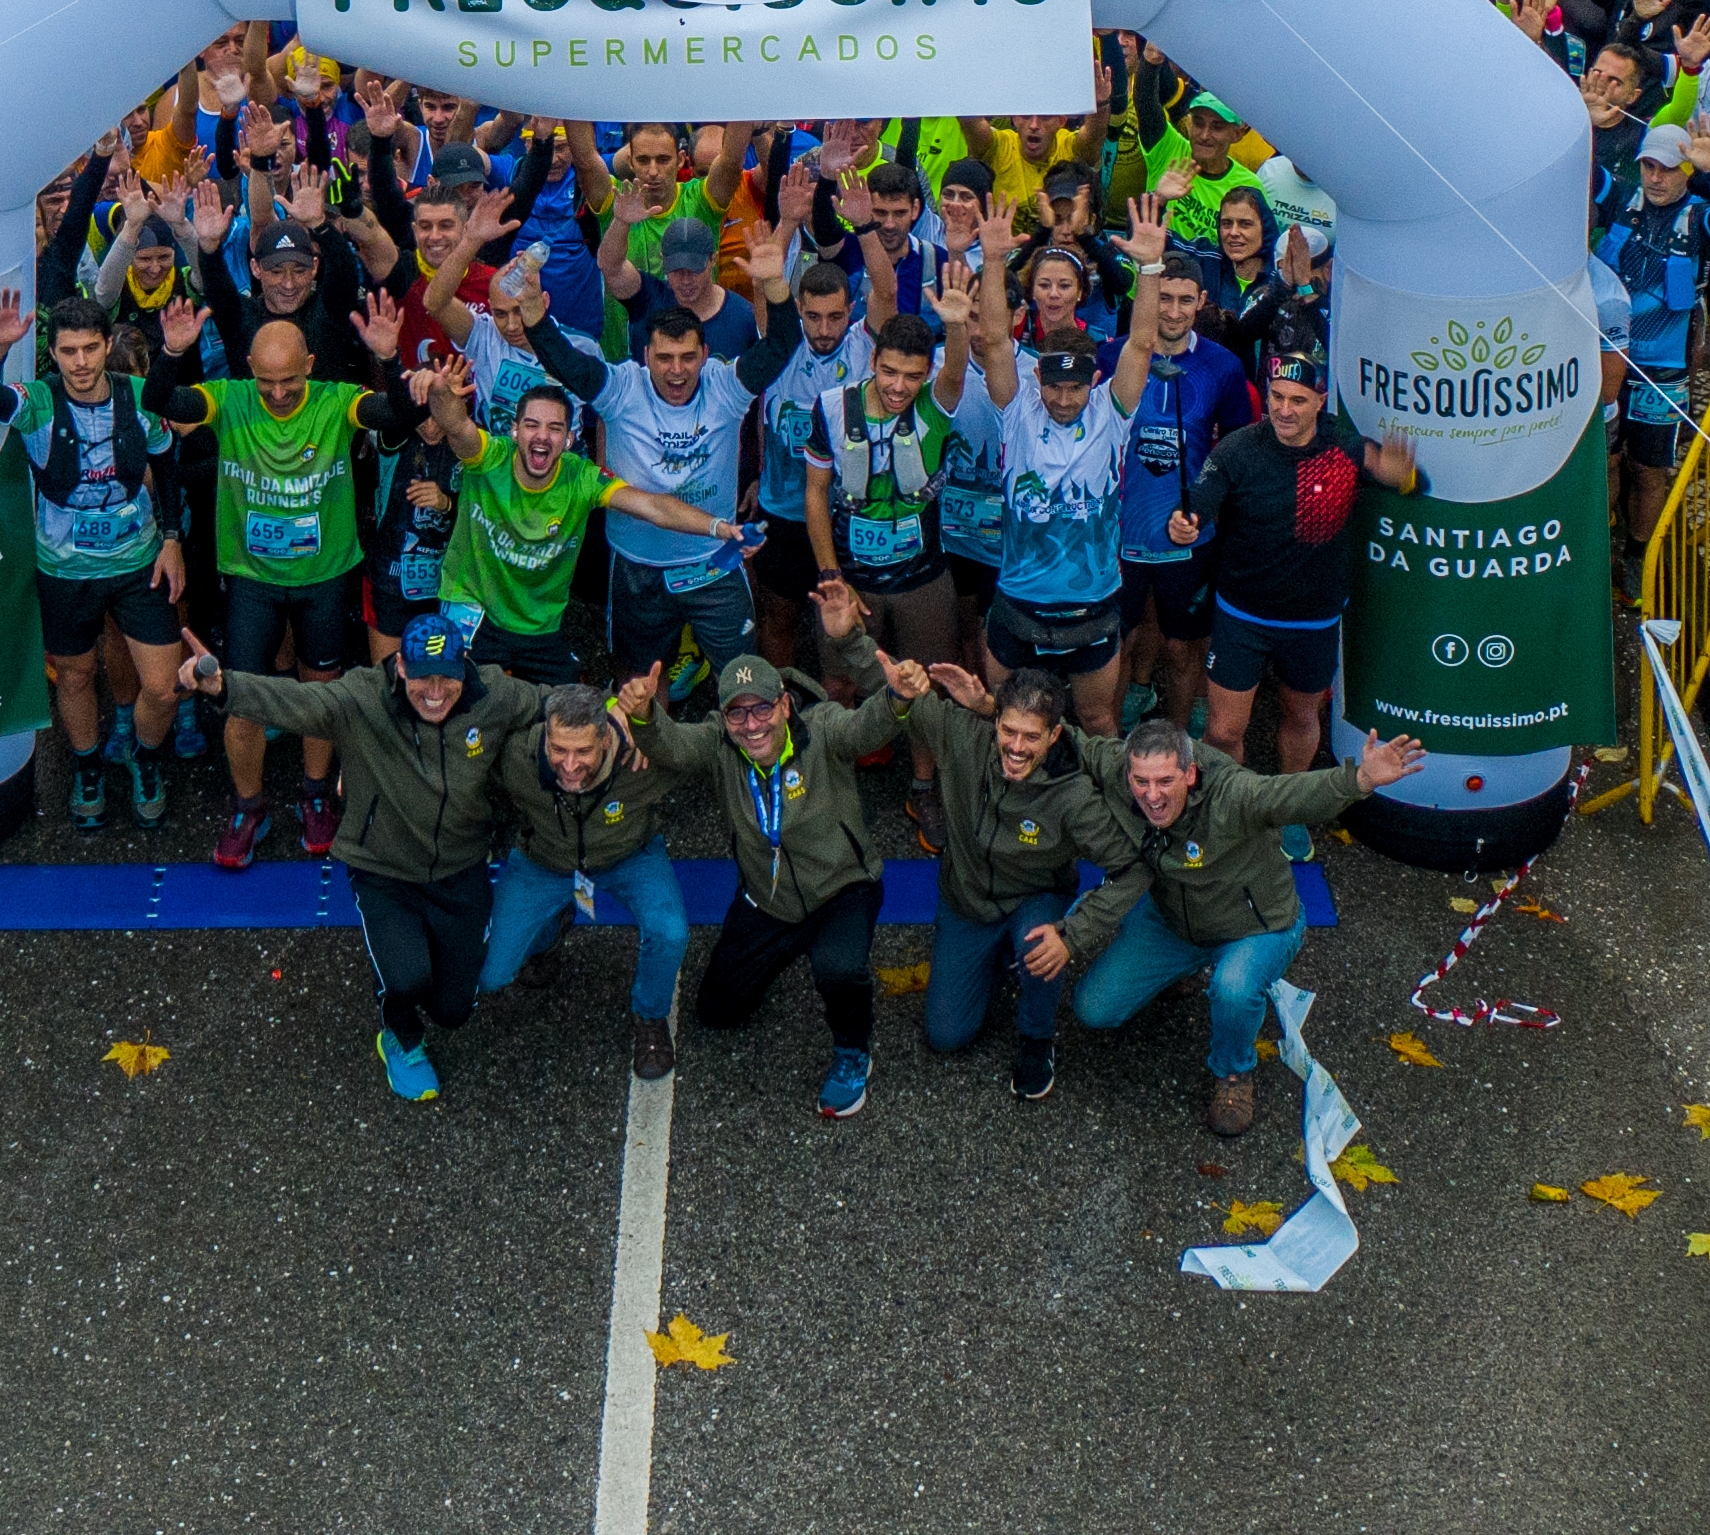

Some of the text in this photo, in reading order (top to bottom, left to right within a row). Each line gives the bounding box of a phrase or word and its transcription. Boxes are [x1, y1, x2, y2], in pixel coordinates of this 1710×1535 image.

[457, 33, 939, 69] SUPERMERCADOS
[1271, 209, 1333, 229] AMIZADE
[1274, 199, 1329, 220] TRAIL DA
[498, 370, 531, 393] 606
[1449, 425, 1496, 442] sempre
[1499, 422, 1526, 440] por
[945, 499, 975, 518] 573
[77, 517, 112, 536] 688
[251, 518, 285, 539] 655
[1378, 515, 1563, 549] SANTIAGO
[854, 529, 888, 547] 596
[1368, 540, 1573, 580] DA GUARDA
[406, 563, 439, 580] 553
[1374, 697, 1570, 730] www.fresquissimo.pt
